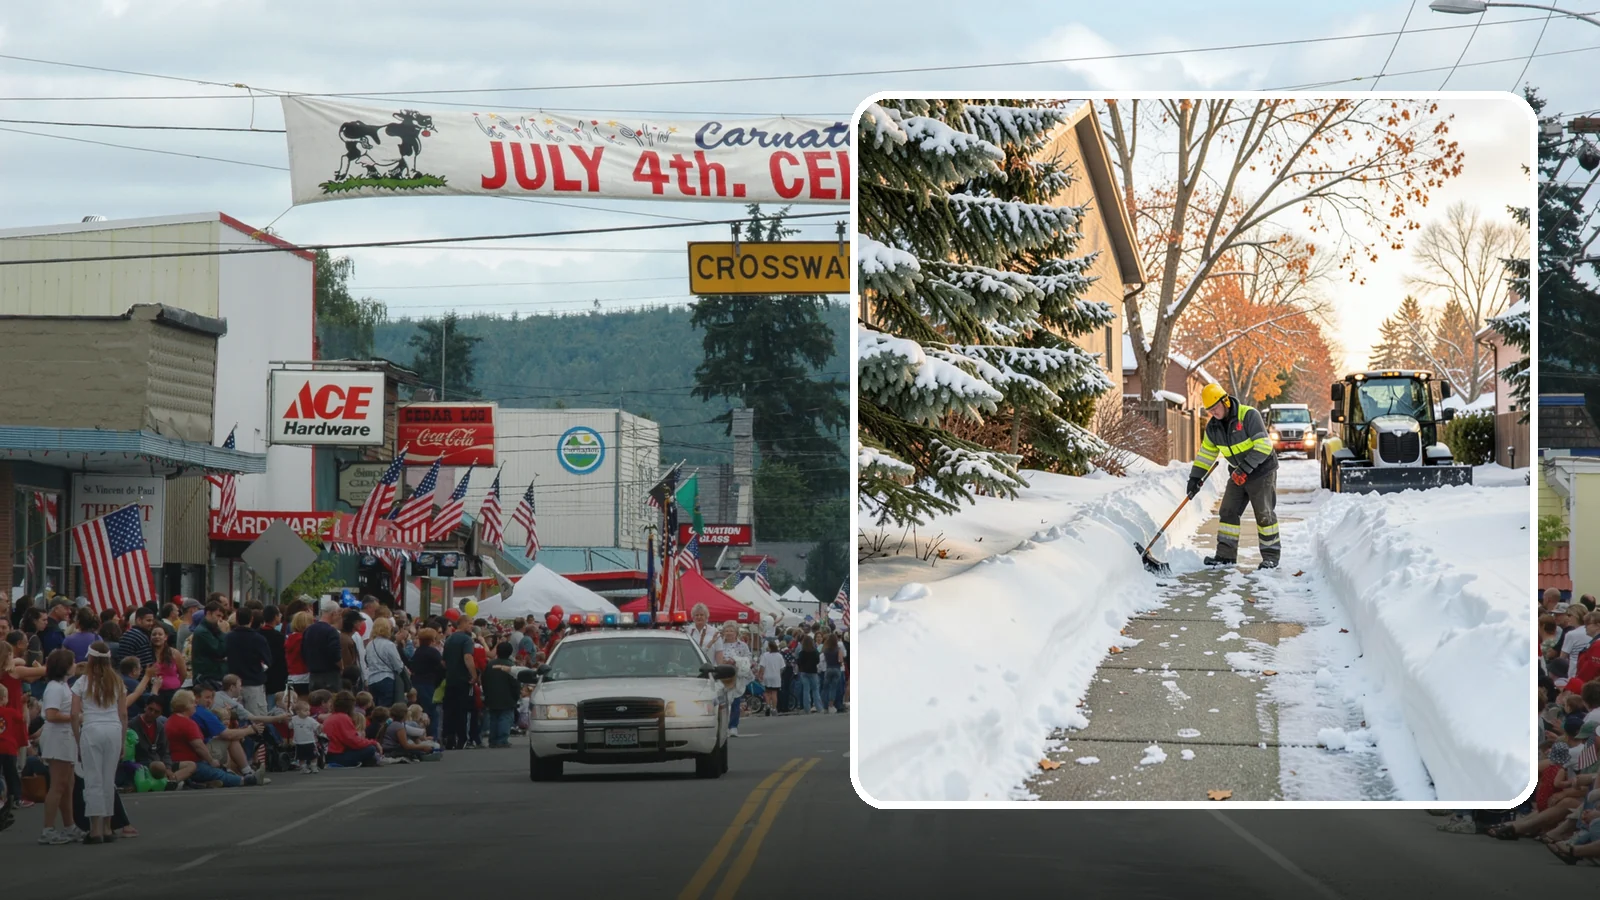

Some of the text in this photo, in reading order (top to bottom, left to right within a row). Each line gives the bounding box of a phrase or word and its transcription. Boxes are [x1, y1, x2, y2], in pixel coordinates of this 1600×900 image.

[481, 141, 605, 193] JULY
[632, 149, 746, 198] 4th.
[697, 254, 850, 280] CROSSWA
[282, 380, 374, 420] ACE
[406, 409, 485, 422] CEDAR LOG
[283, 421, 371, 436] Hardware
[416, 428, 477, 447] Coca-Cola
[353, 467, 384, 480] Simpl
[96, 485, 124, 495] Vincent
[126, 486, 136, 495] de
[138, 486, 155, 495] Paul
[688, 526, 741, 535] CRNATION
[699, 535, 730, 543] GLASS
